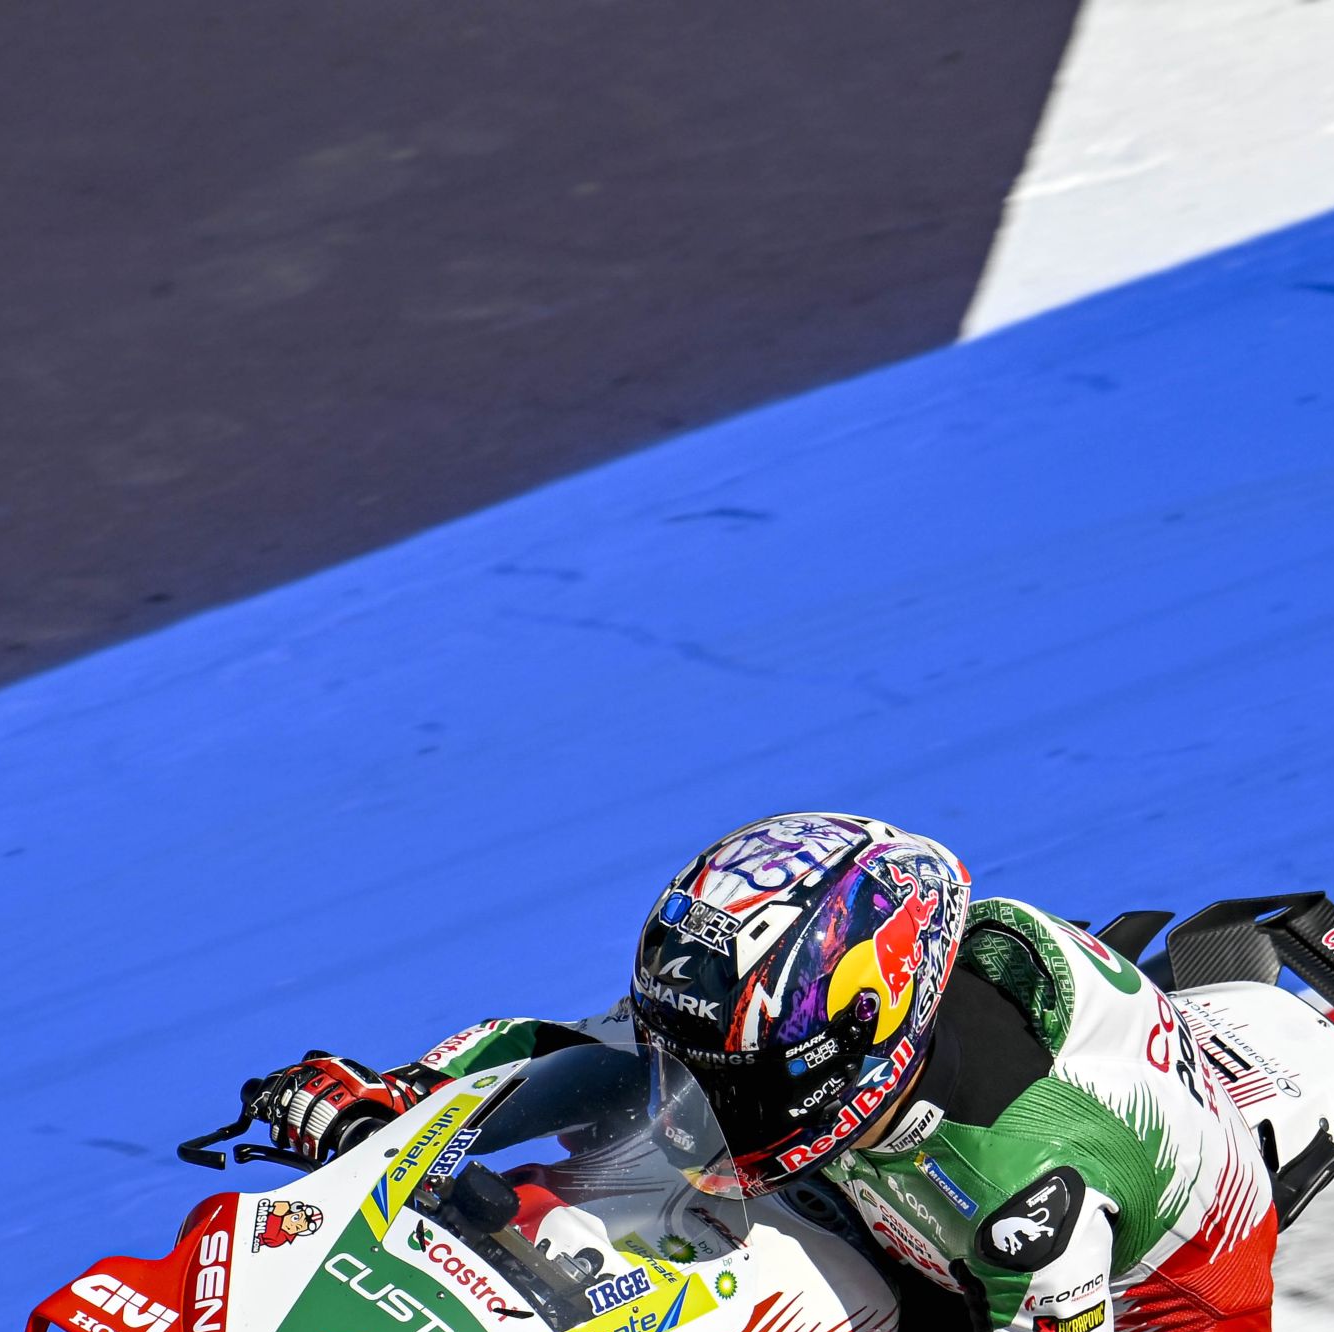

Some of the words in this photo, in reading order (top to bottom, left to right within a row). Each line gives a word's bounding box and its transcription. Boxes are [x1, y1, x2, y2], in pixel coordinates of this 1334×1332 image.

[640, 967, 720, 1020] SHARK
[687, 1048, 755, 1065] WINGS
[785, 1032, 826, 1058] SHARK
[804, 1039, 835, 1061] QUAD
[807, 1048, 838, 1069] LOCK
[776, 1105, 861, 1173] Red
[851, 1036, 915, 1118] Bull
[389, 1107, 460, 1182] ultimate
[427, 1128, 482, 1176] IRGE
[927, 1170, 970, 1210] MICHELIN
[880, 1205, 928, 1250] Castrol
[585, 1267, 652, 1316] IRGE
